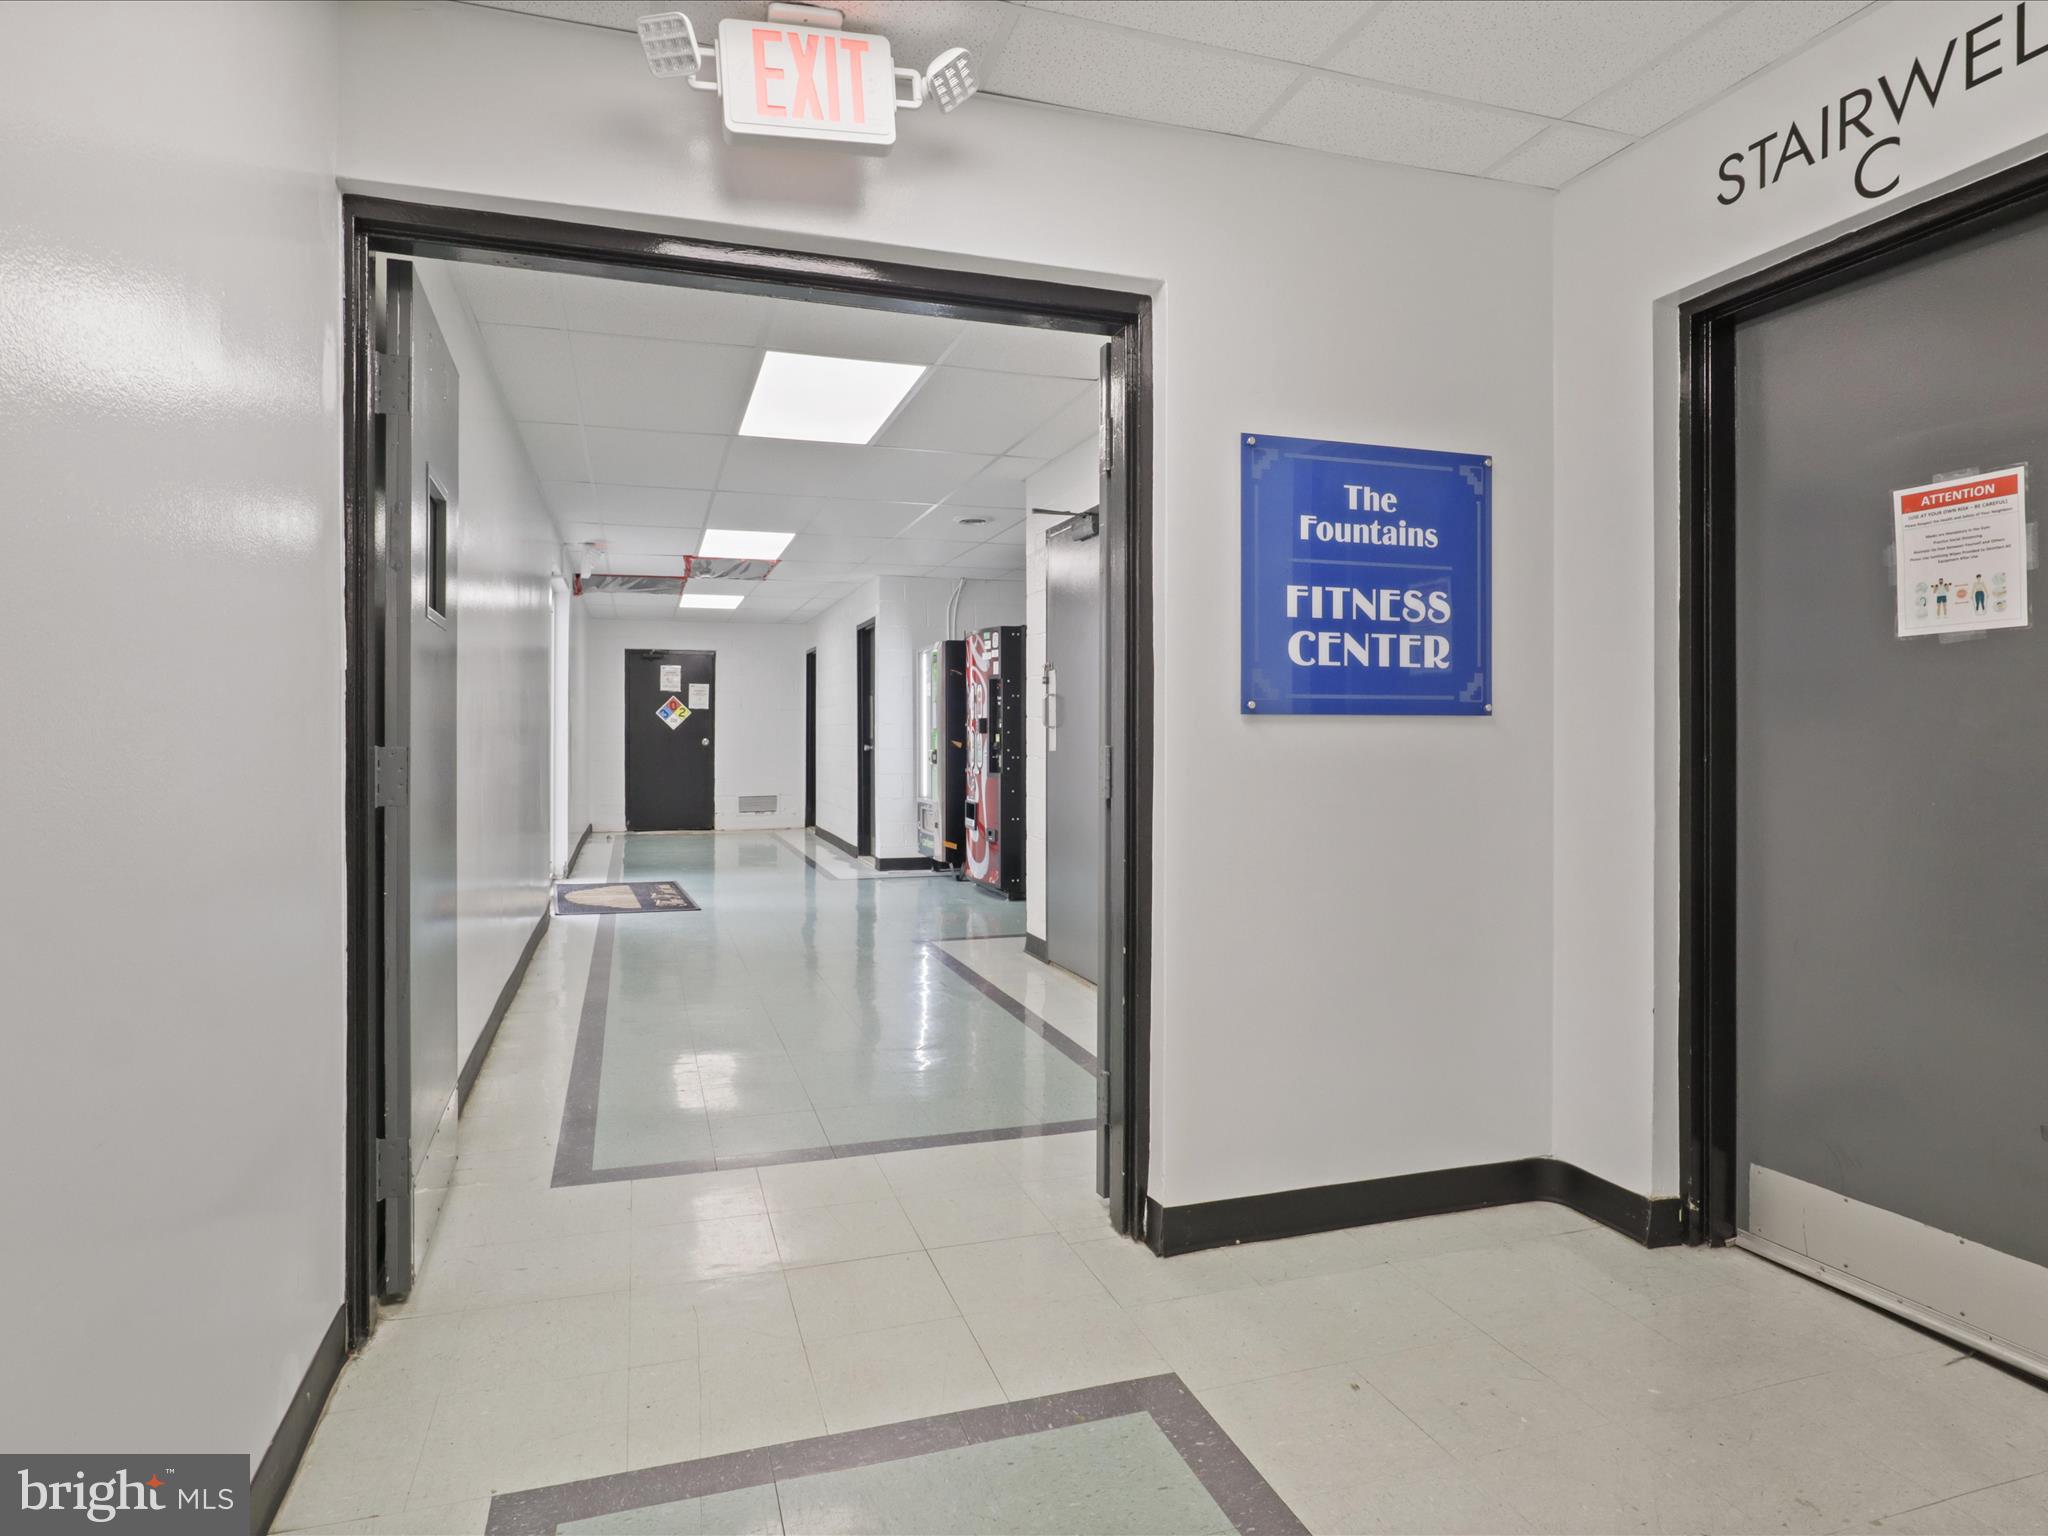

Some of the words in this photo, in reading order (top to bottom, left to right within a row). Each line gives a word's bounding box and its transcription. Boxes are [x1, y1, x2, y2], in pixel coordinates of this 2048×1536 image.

[752, 28, 869, 123] EXIT
[1854, 136, 1900, 199] C
[1344, 484, 1397, 513] The
[1921, 484, 1995, 506] ATTENTION
[1300, 514, 1438, 548] Fountains
[1286, 584, 1452, 624] FITNESS
[1287, 630, 1451, 670] CENTER
[678, 707, 686, 718] 2
